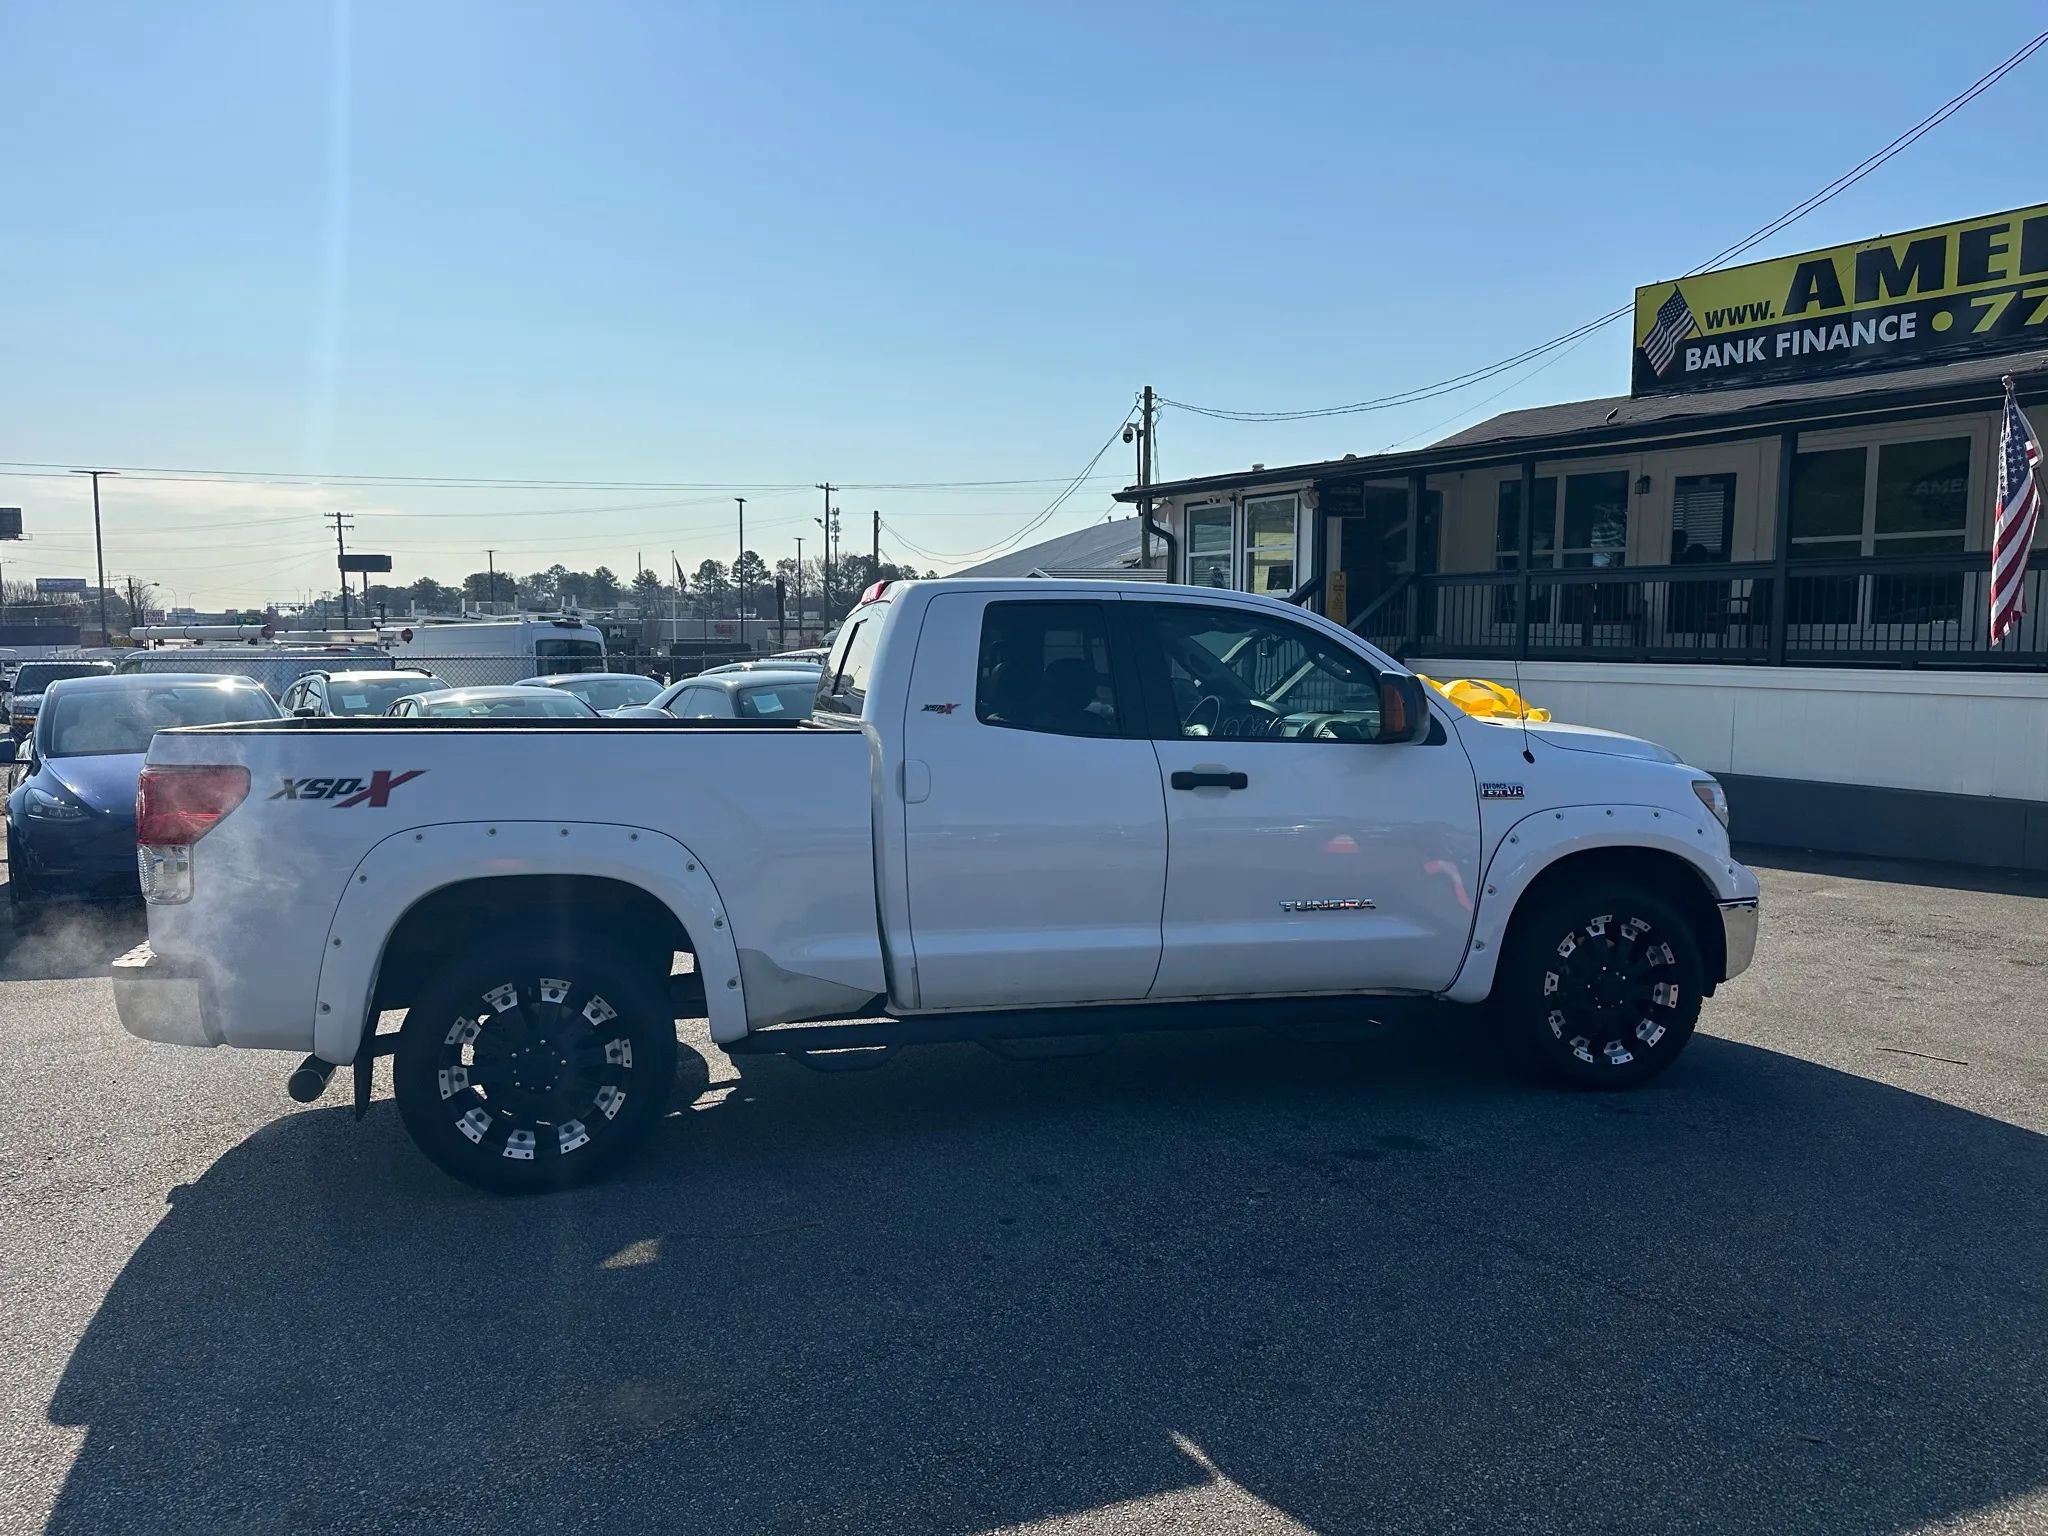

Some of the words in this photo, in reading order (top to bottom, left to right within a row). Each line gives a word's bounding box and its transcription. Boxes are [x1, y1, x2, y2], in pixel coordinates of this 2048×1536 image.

[1685, 335, 1767, 372] BANK
[1775, 311, 1917, 358] FINANCE
[265, 768, 432, 809] XSP-X
[1507, 785, 1524, 796] V8
[1280, 898, 1376, 912] TUNDRA
